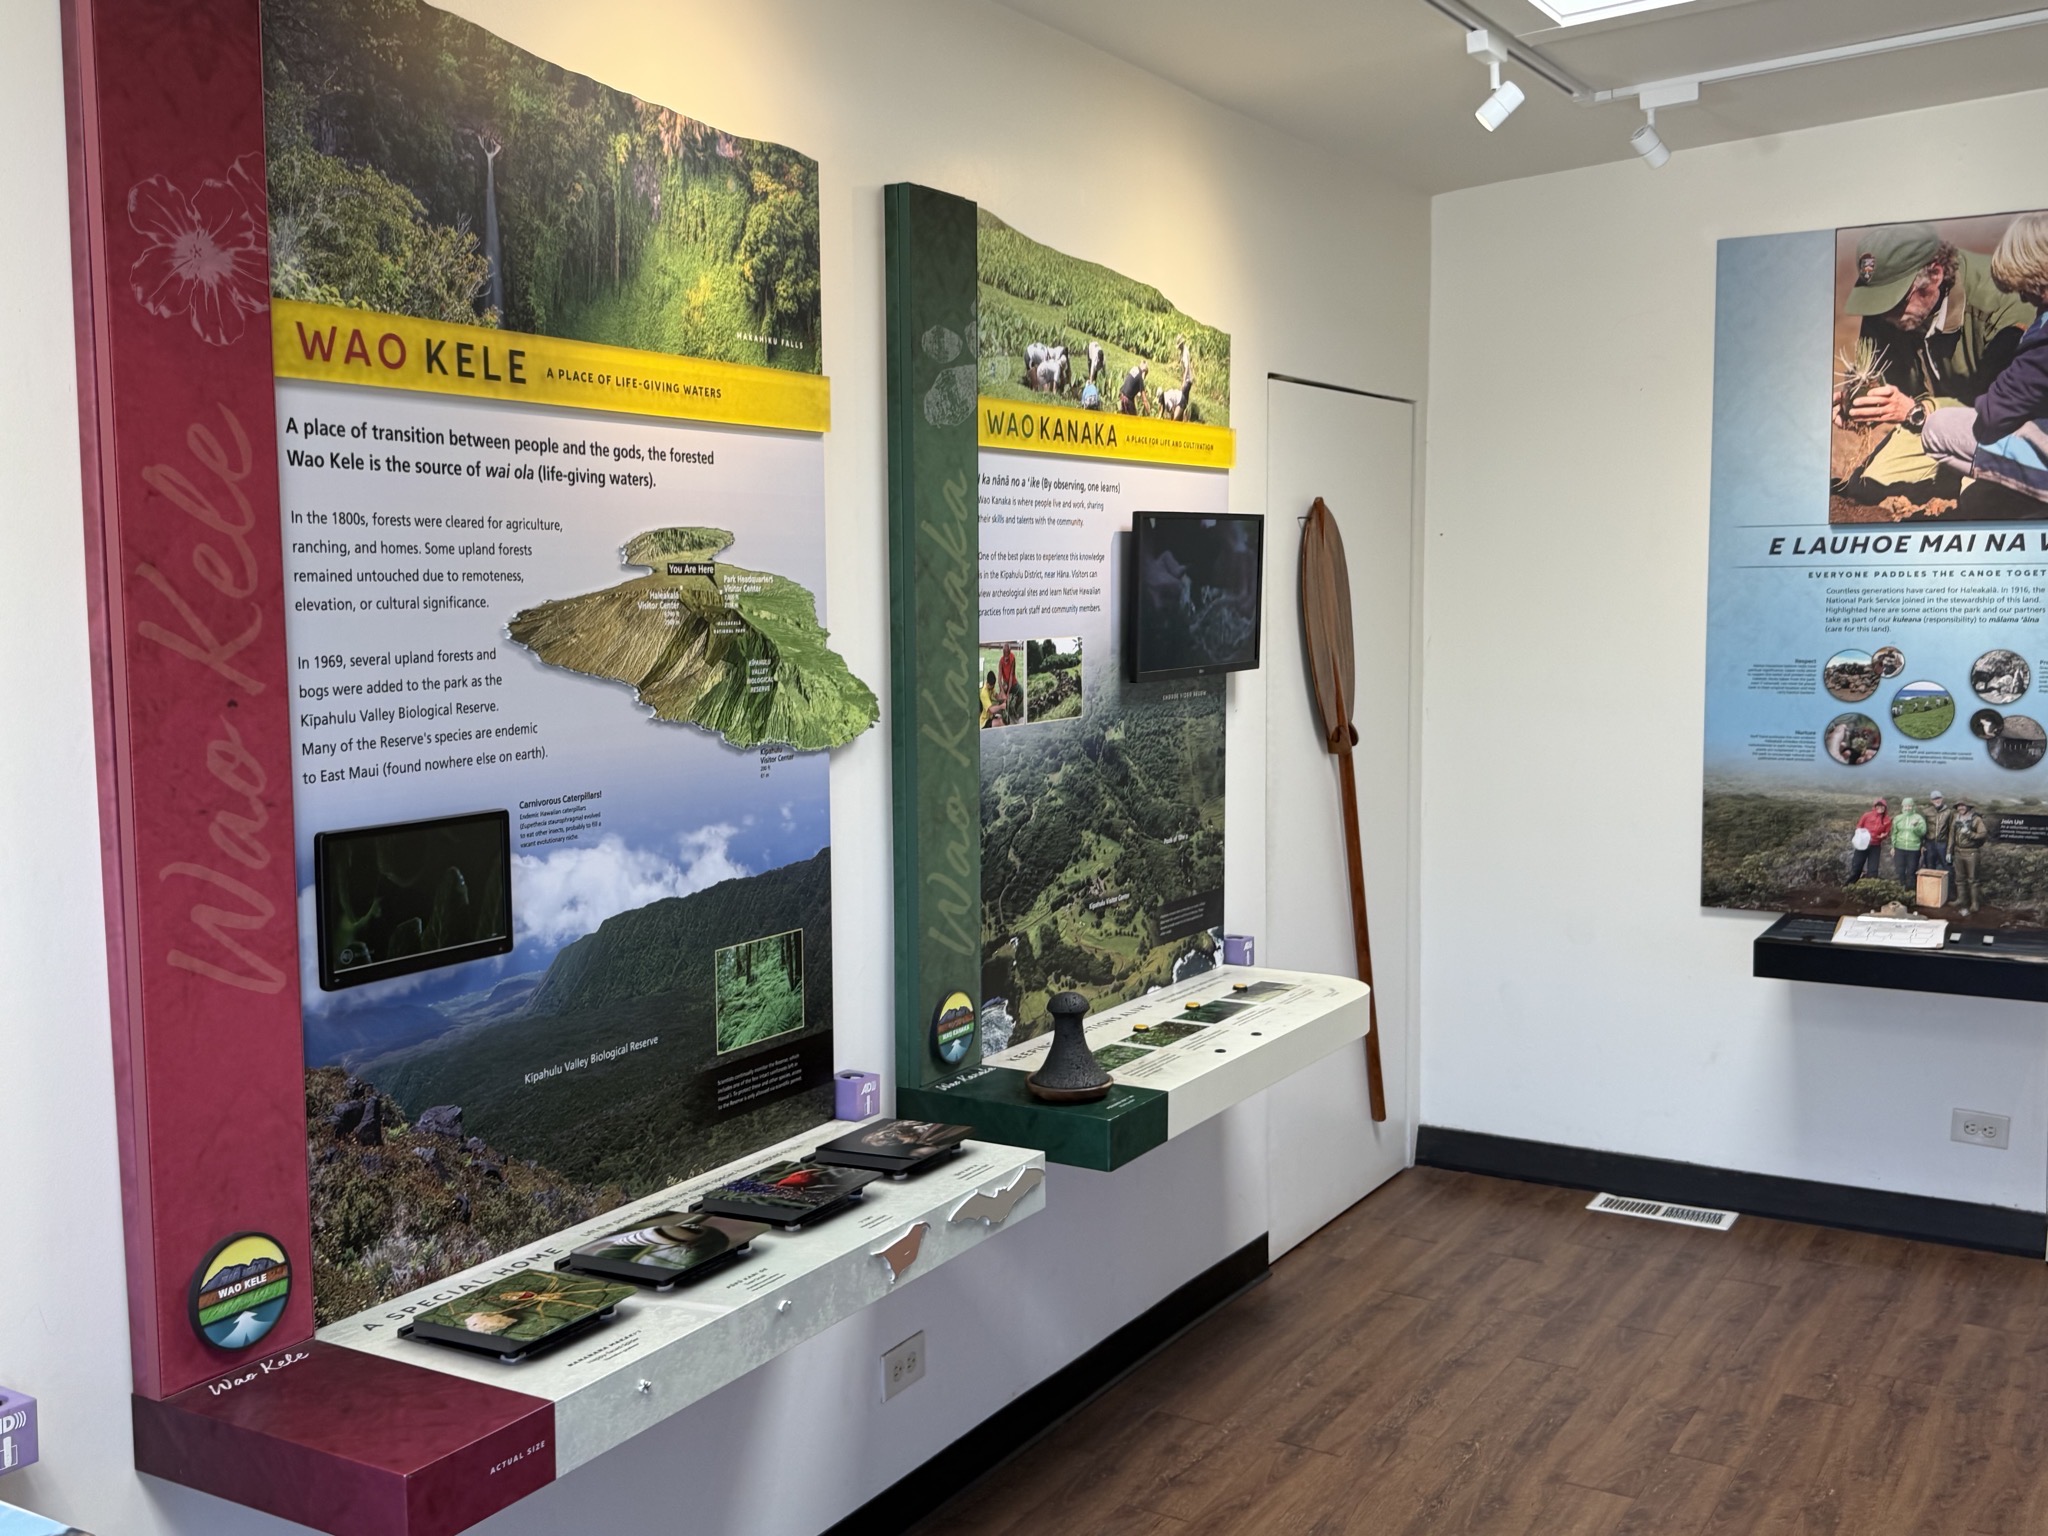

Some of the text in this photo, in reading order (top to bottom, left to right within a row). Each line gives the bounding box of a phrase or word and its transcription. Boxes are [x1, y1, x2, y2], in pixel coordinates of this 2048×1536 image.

[296, 321, 528, 385] WAO KELE
[781, 338, 803, 349] FALLS
[547, 368, 721, 398] A PLACE OF LIFE-GIVING WATERS
[286, 417, 714, 464] A place of transition between people and the gods, the forested
[987, 410, 1117, 447] WAO KANAKA
[1132, 436, 1147, 444] PLACE
[1184, 441, 1214, 450] CULTIVATION
[286, 449, 656, 489] Wao Kele is the source of wai ola (life-giving waters).
[982, 473, 990, 484] ka
[1011, 478, 1020, 487] no
[1022, 479, 1026, 487] a
[1042, 478, 1052, 492] (By
[1054, 478, 1086, 493] observing,
[1088, 482, 1099, 492] one
[1100, 481, 1120, 494] learns)
[291, 510, 562, 532] In the 1800s, forests were cleared for agriculture,
[136, 402, 265, 695] Kele
[292, 539, 532, 558] ranching, and homes. Some upland forests
[1769, 538, 1786, 555] E
[1792, 535, 1911, 555] LAUHOE
[1919, 534, 1976, 553] MAI
[1984, 533, 2026, 551] NA
[294, 568, 523, 583] remained untouched due to remoteness,
[669, 565, 714, 574] You Are Here
[295, 595, 488, 612] elevation, or cultural significance.
[921, 467, 970, 767] Kanaka
[298, 647, 496, 669] In 1969, several upland forests and
[298, 674, 502, 699] bogs were added to the park as the
[300, 702, 498, 728] Kīpahulu Valley Biological Reserve.
[302, 722, 537, 756] Many of the Reserve's species are endemic
[302, 746, 548, 784] to East Maui (found nowhere else on earth).
[519, 790, 602, 809] Carnivorous Caterpillars!
[159, 715, 286, 994] Wao
[927, 784, 976, 957] Wao
[564, 1058, 588, 1072] Valley
[590, 1042, 628, 1064] Biological
[630, 1036, 658, 1052] Reserve
[218, 1274, 267, 1298] WAO KELE
[363, 1248, 563, 1332] A SPECIAL HOME
[208, 1353, 310, 1395] Wao Kele
[490, 1440, 545, 1475] ACTUAL SIZE
